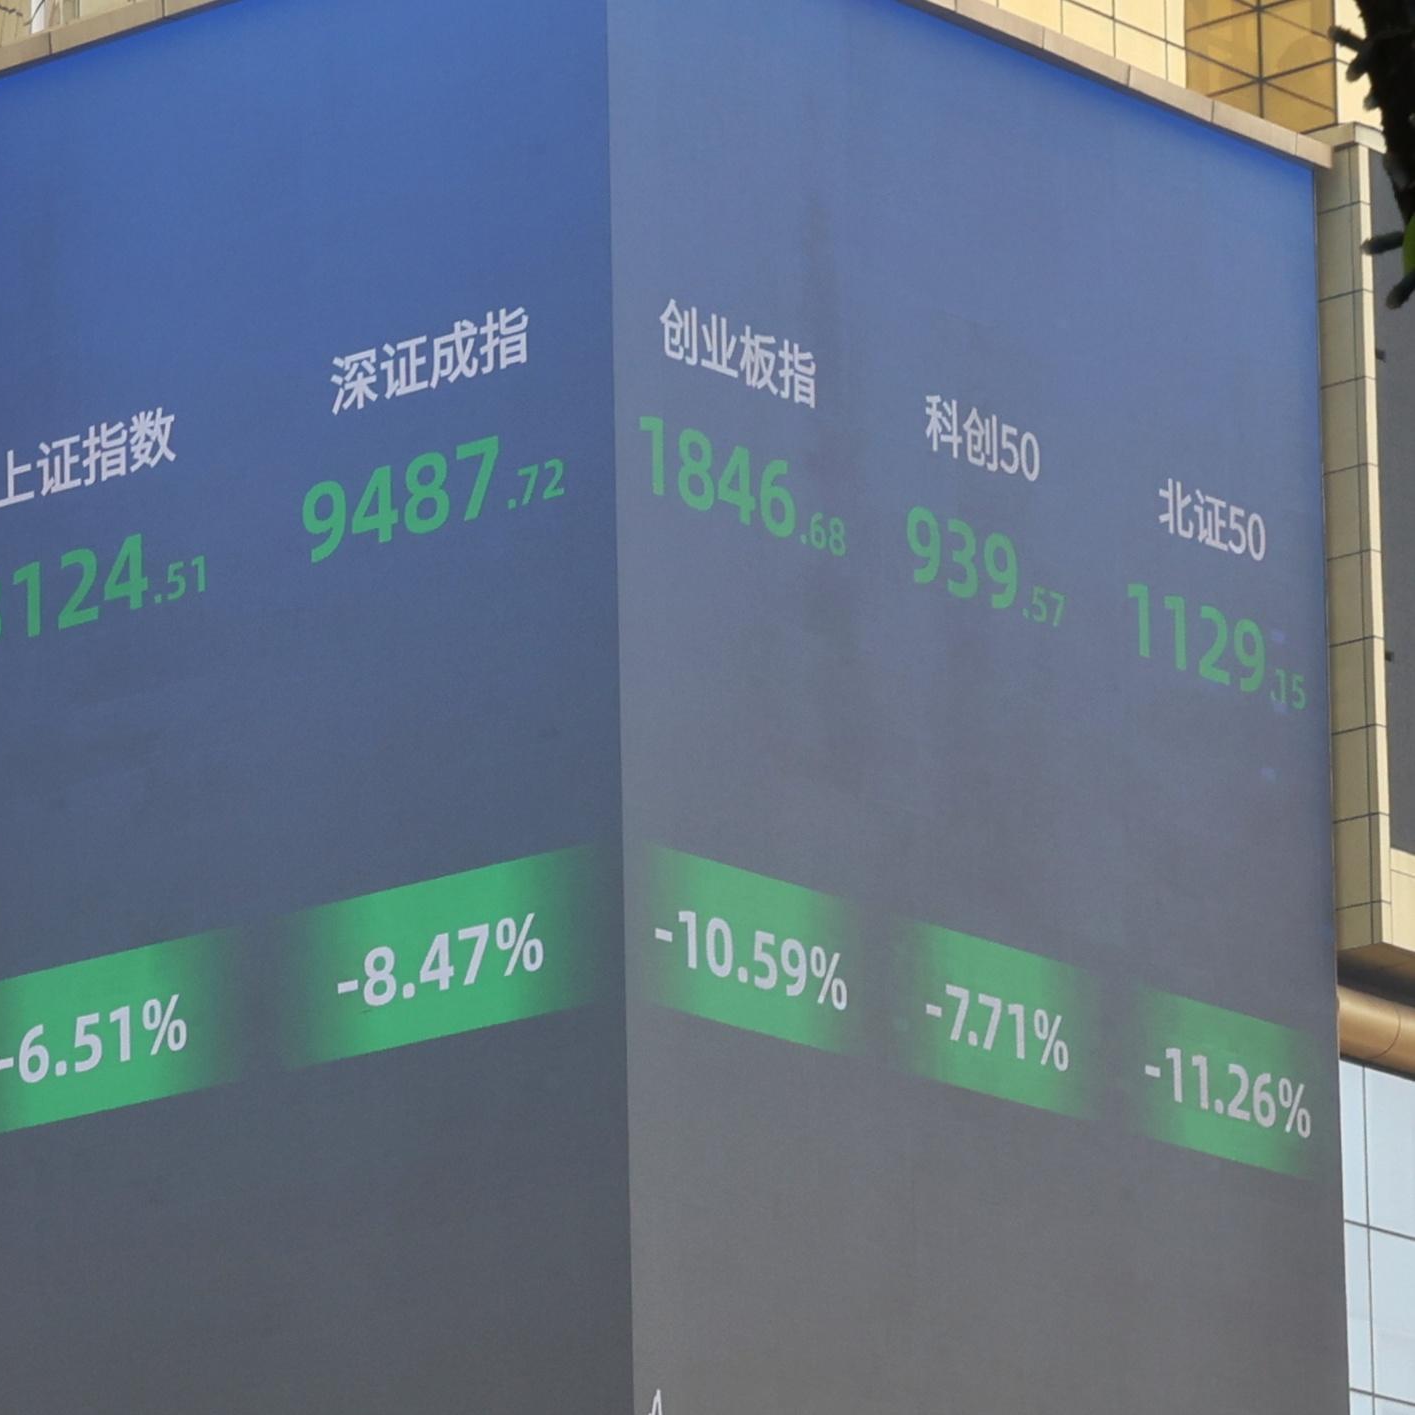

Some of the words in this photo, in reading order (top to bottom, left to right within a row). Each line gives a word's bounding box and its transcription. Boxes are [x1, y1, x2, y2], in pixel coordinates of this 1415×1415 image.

[330, 306, 530, 415] 深证成指
[659, 298, 816, 409] 创业板指
[639, 416, 846, 556] 1846.68
[925, 394, 1040, 482] 科创50
[302, 435, 566, 564] 9487.72
[1158, 478, 1268, 562] 北证50
[337, 912, 545, 1008] -8.47%
[654, 910, 848, 1013] -10.59%
[925, 983, 1071, 1073] -7.71%
[1144, 1047, 1313, 1140] -11.26%
